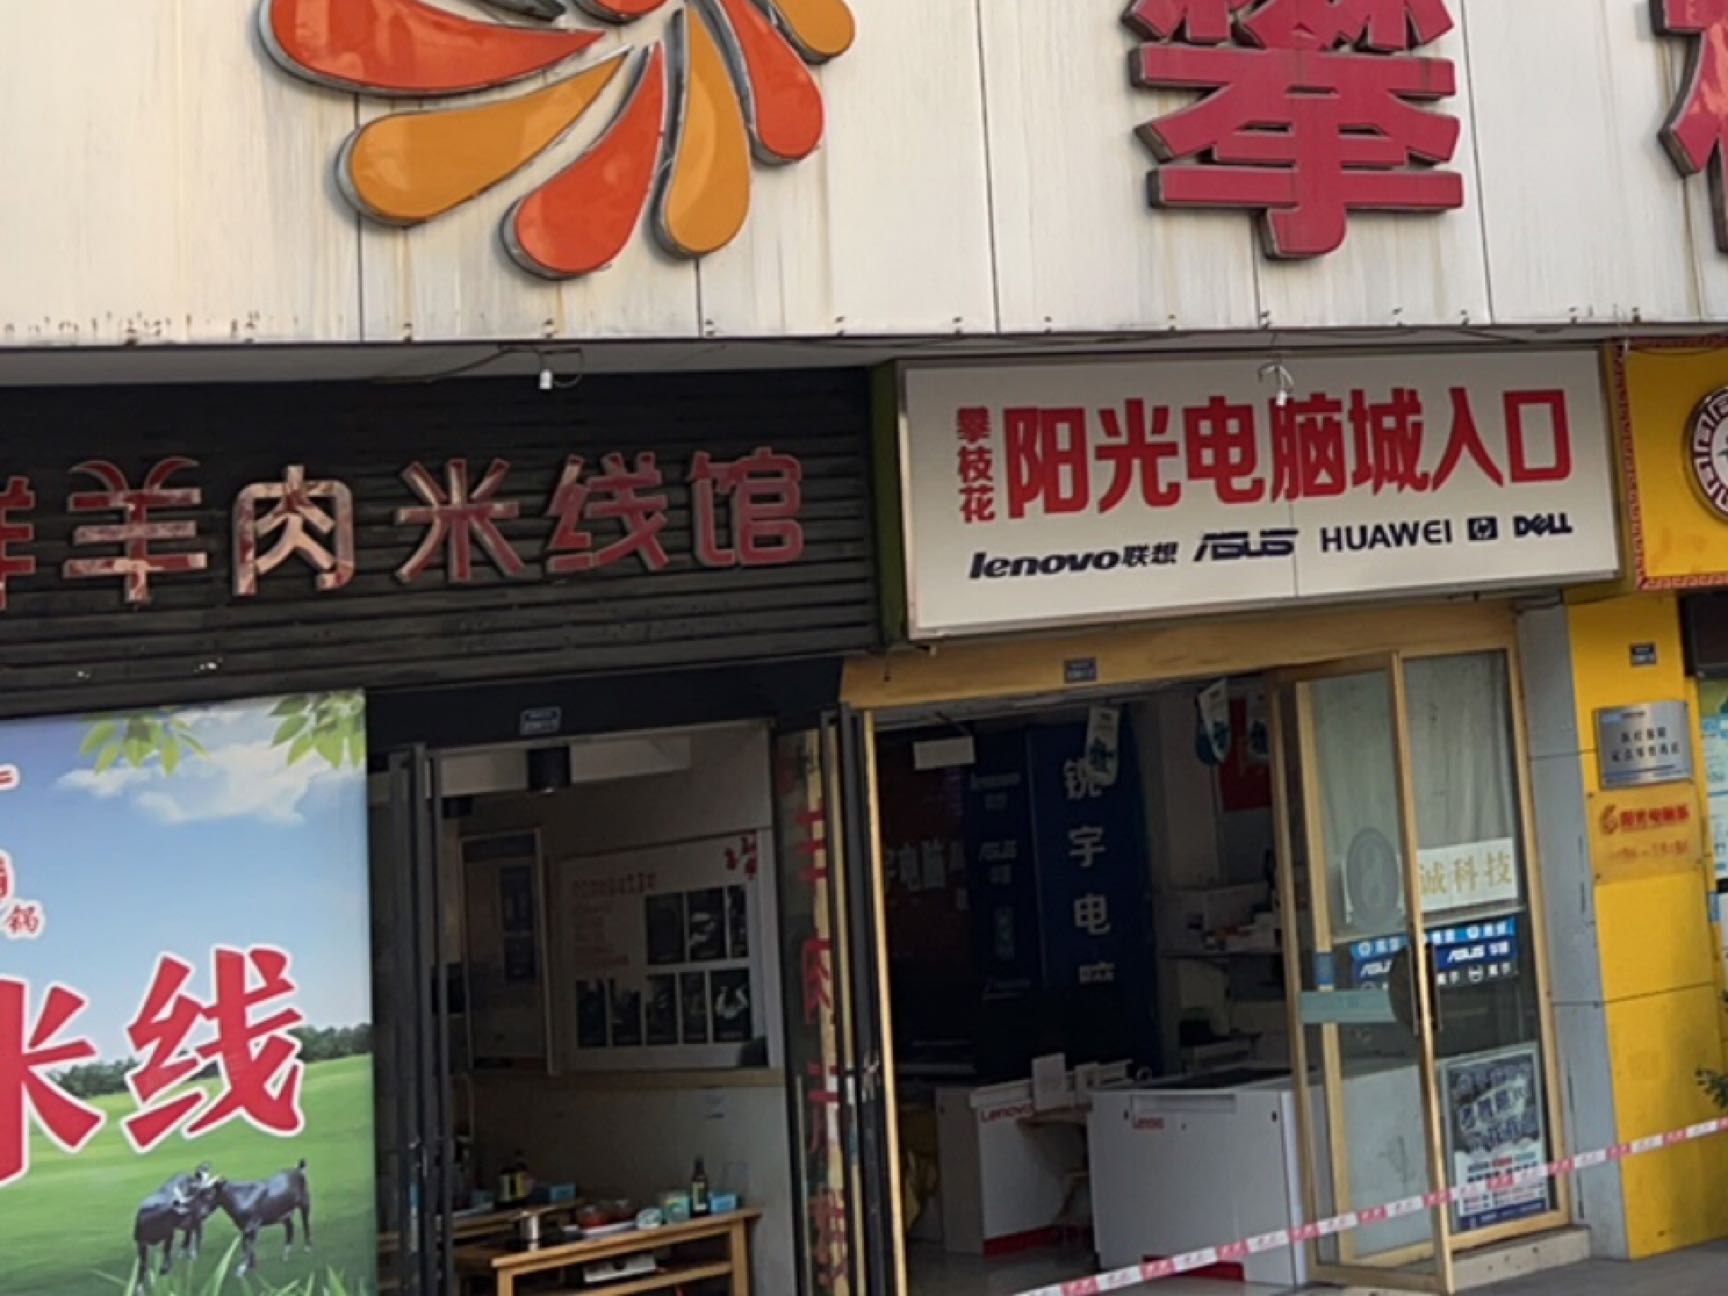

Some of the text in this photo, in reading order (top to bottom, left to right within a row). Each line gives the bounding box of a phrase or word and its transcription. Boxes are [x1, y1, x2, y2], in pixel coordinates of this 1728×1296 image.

[957, 406, 996, 524] 攀枝花
[1003, 387, 1571, 519] 阳光电脑城入口
[0, 445, 804, 611] 羊肉米线馆
[1193, 528, 1299, 562] ASUS
[1320, 519, 1453, 553] HUAWEI
[1512, 512, 1573, 538] DELL
